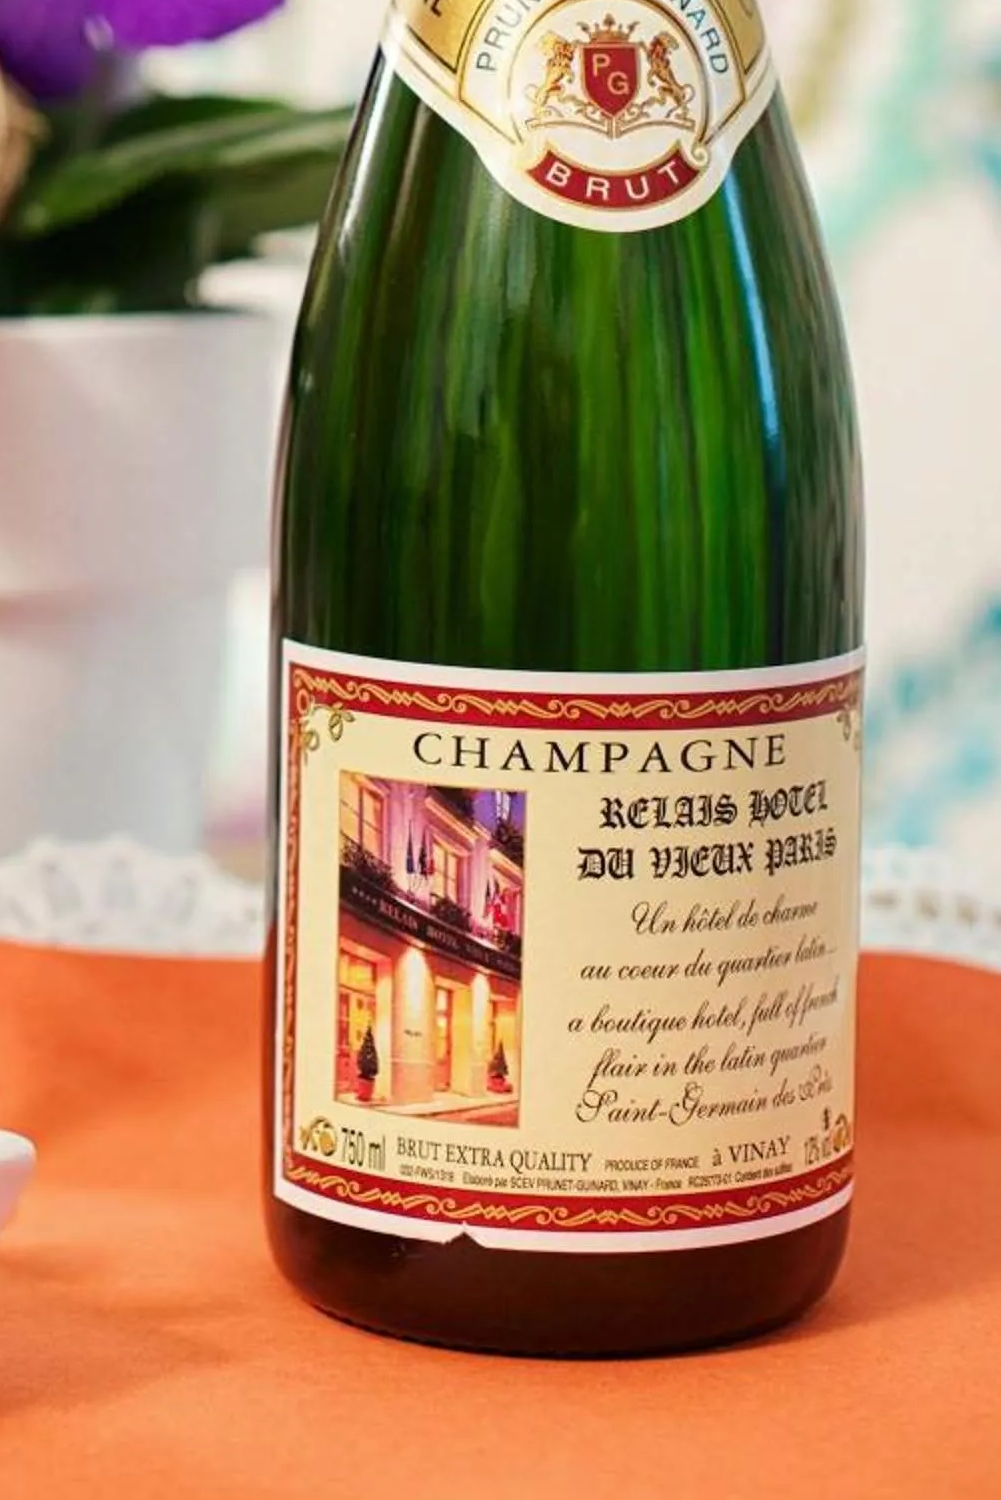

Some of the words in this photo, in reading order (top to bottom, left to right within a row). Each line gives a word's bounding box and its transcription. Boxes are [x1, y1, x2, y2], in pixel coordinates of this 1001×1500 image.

[546, 159, 686, 200] BRUT
[413, 732, 788, 774] CHAMPAGNE
[599, 793, 738, 829] RELAIS
[748, 779, 828, 827] HOTEL
[578, 847, 635, 881] DU
[651, 841, 754, 880] VIEUX
[765, 827, 838, 877] PARIS
[630, 900, 678, 935] Un
[682, 900, 740, 933] hôtel
[737, 897, 759, 928] de
[762, 893, 819, 925] charme
[580, 965, 612, 980] au
[617, 962, 680, 981] coeur
[684, 947, 714, 977] du
[716, 945, 793, 987] quartier
[567, 1016, 585, 1033] a
[590, 1003, 688, 1044] boutique
[690, 997, 747, 1031] hotel,
[746, 990, 789, 1037] full
[784, 984, 807, 1028] of
[586, 1048, 649, 1090] flair
[651, 1053, 678, 1077] in
[683, 1044, 716, 1076] the
[719, 1041, 766, 1072] latin
[769, 1031, 827, 1076] quartier
[575, 1081, 768, 1127] Saint-Germain
[772, 1077, 795, 1106] des
[340, 1127, 365, 1168] 750
[368, 1134, 387, 1172] ml
[396, 1136, 443, 1162] BRUT
[445, 1143, 505, 1169] EXTRA
[510, 1150, 593, 1174] QUALITY
[604, 1158, 649, 1172] PRODUCE
[650, 1158, 663, 1171] OF
[664, 1155, 699, 1170] FRANCE
[728, 1135, 791, 1164] VINAY
